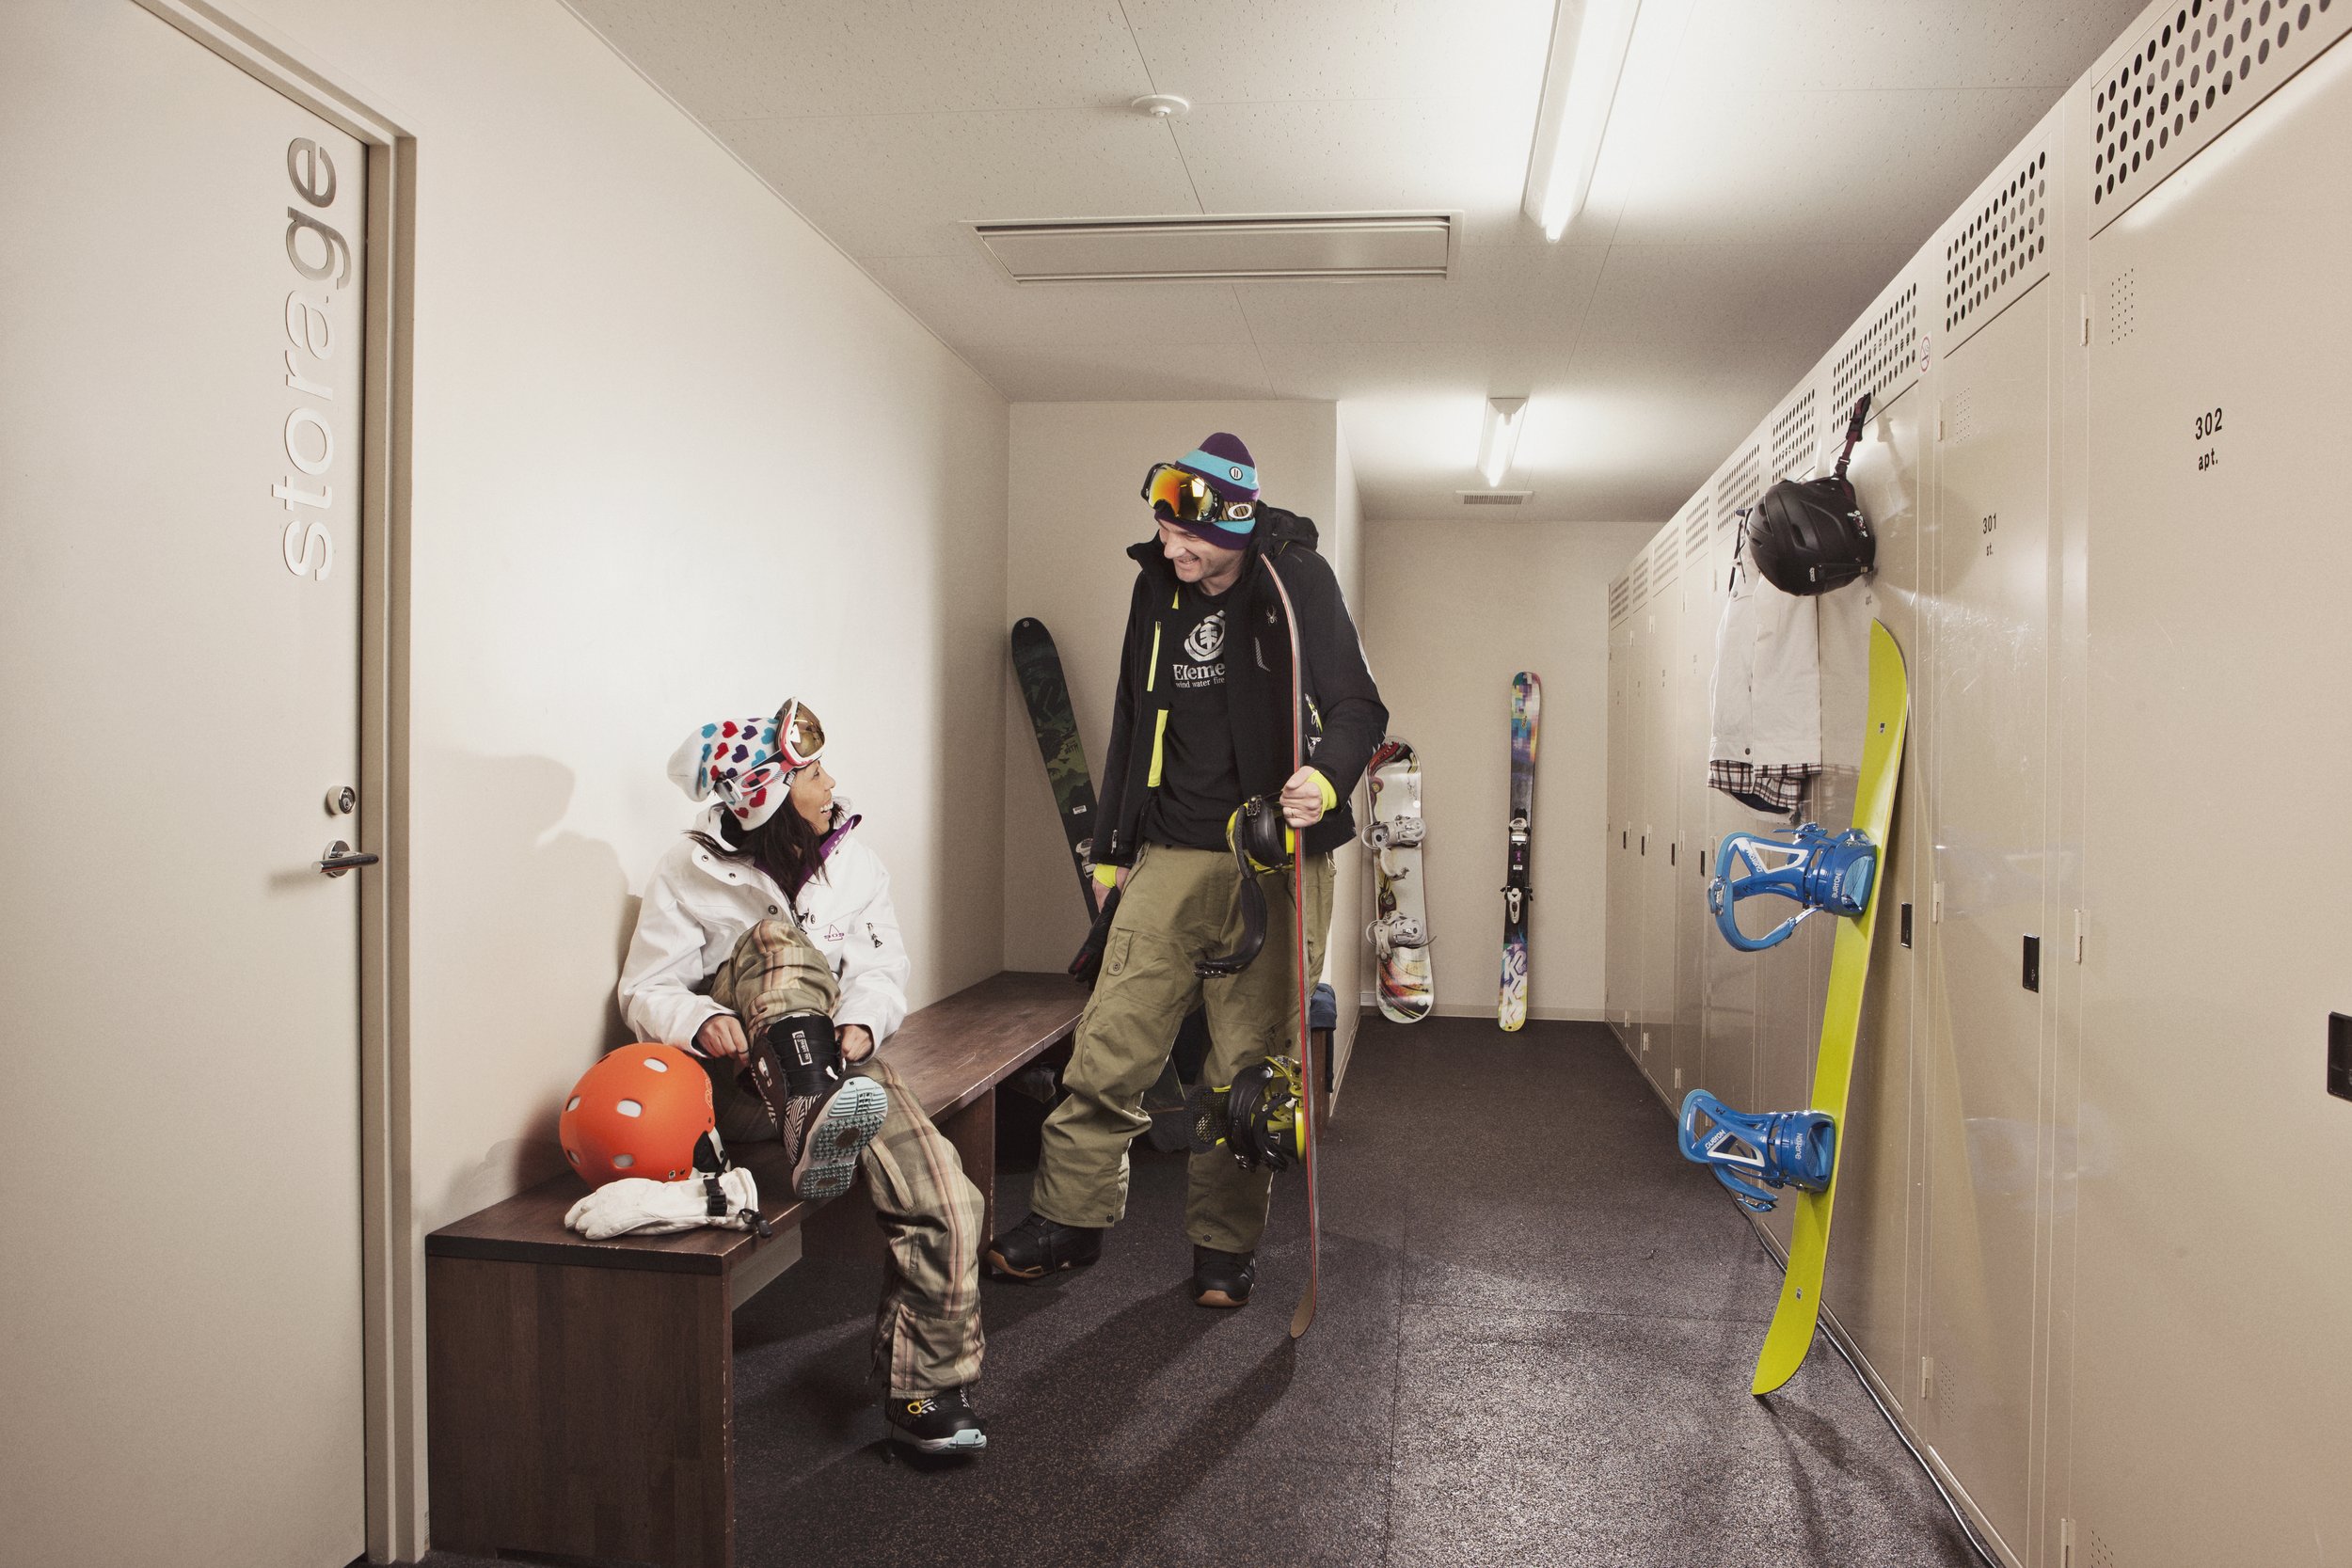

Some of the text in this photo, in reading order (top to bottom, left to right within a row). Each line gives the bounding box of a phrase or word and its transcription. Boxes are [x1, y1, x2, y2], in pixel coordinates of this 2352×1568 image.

[271, 136, 352, 581] storage
[2195, 407, 2222, 440] 302
[2198, 447, 2218, 471] apt.
[1982, 512, 1996, 534] 301
[1192, 679, 1210, 688] water
[1831, 872, 1842, 899] BURTON
[1794, 1132, 1804, 1161] BURTON
